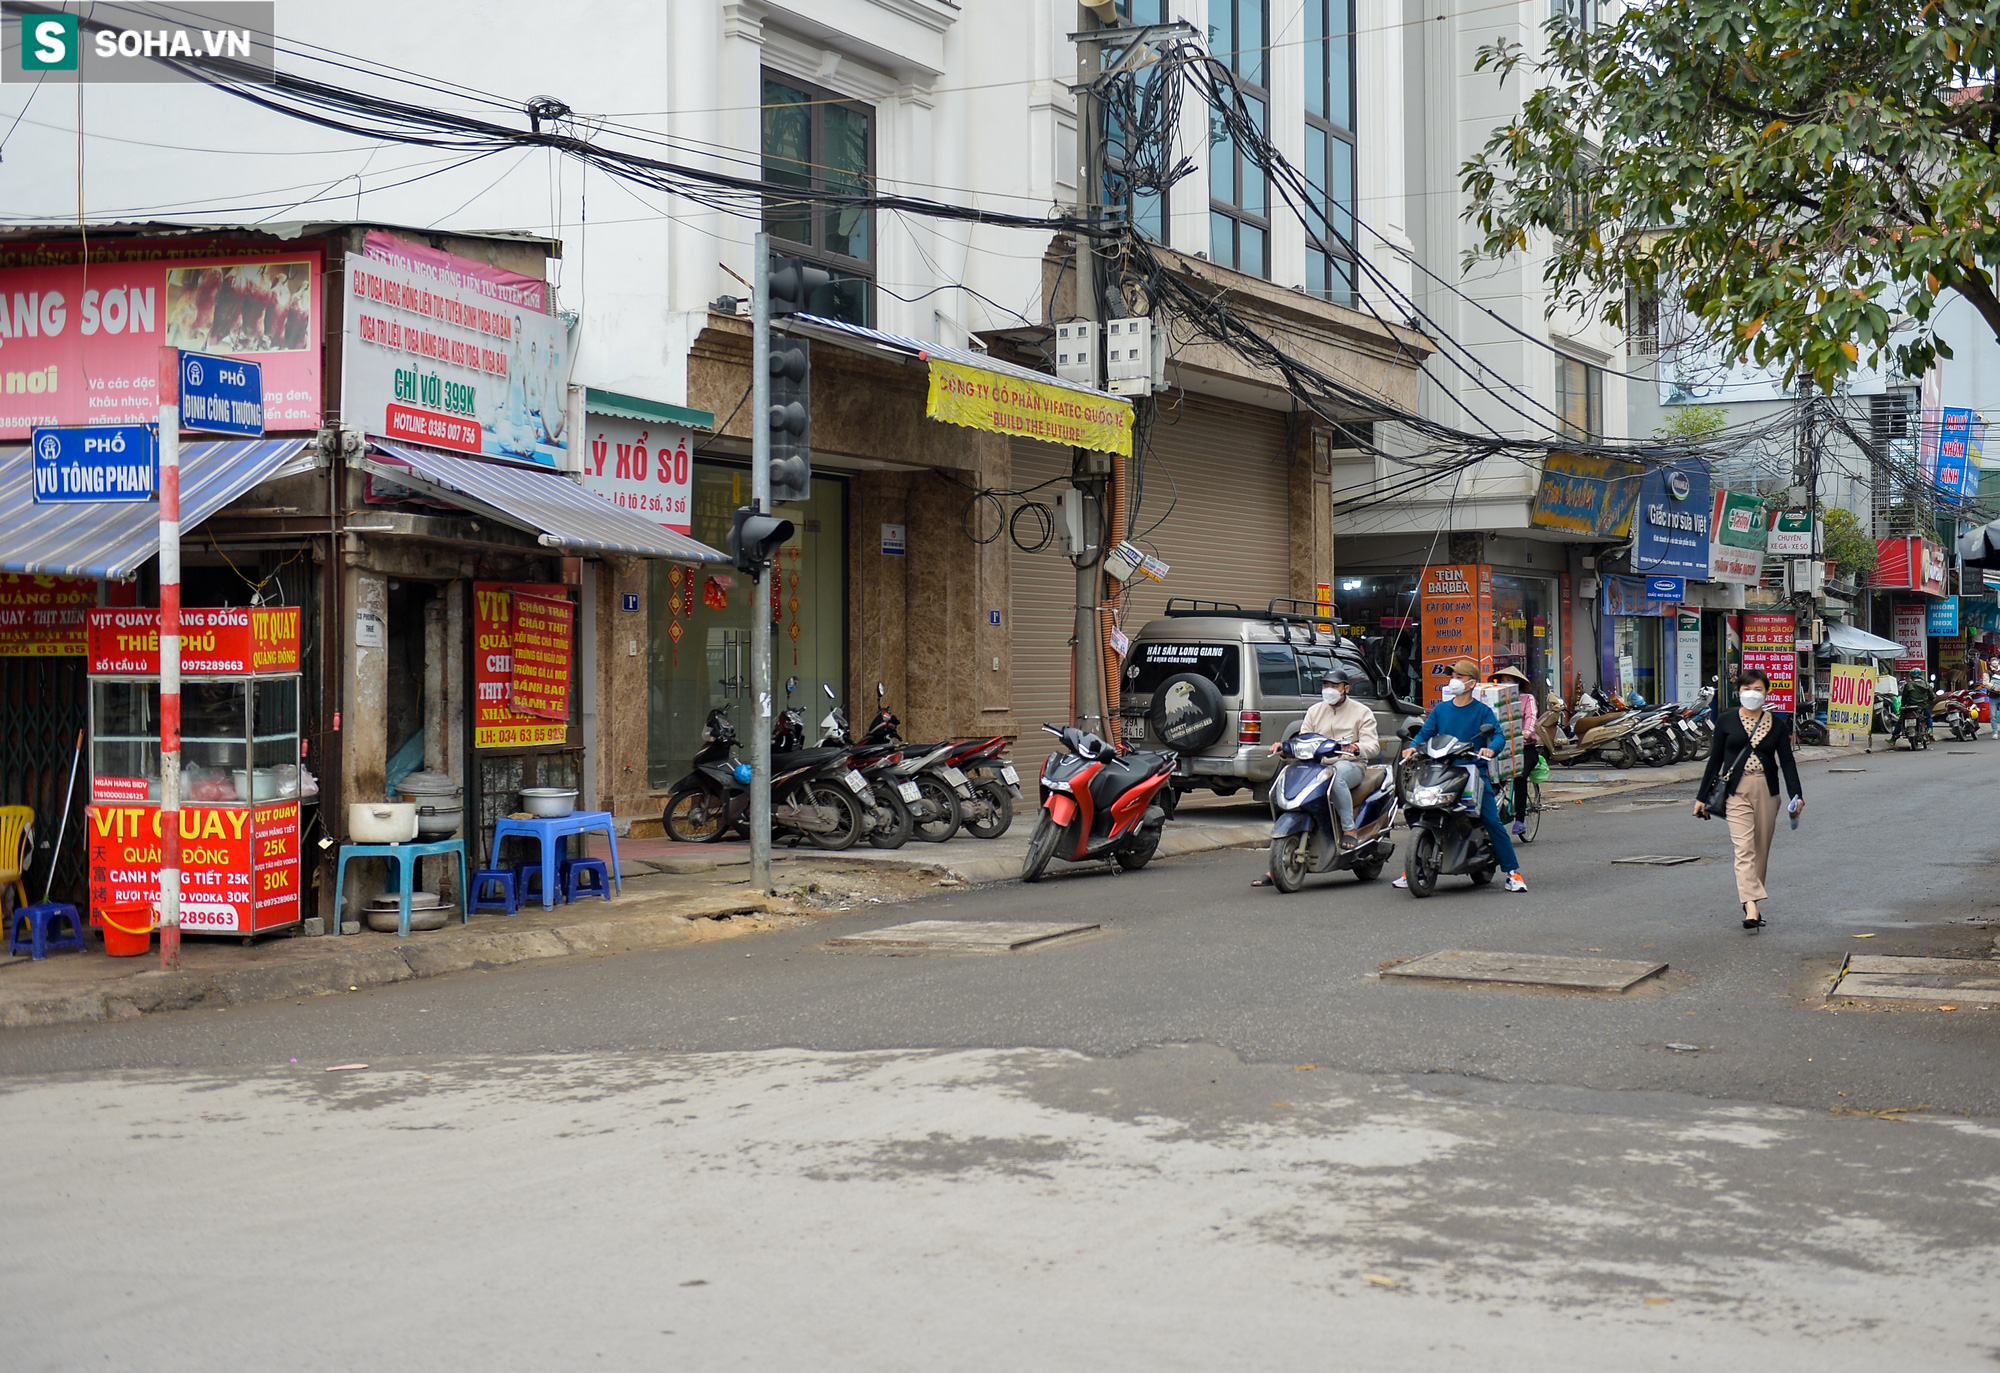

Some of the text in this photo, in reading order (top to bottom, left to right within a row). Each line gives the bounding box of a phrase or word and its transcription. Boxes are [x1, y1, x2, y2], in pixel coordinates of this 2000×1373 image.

[388, 253, 415, 273] YOGA
[81, 284, 155, 335] SƠN
[367, 273, 382, 301] YOGA
[463, 304, 477, 331] SINH
[478, 308, 491, 335] YOGA
[360, 313, 375, 342] YOGA
[404, 326, 419, 354] YOGA
[6, 365, 58, 394] nơi
[89, 377, 155, 391] Và các đặc
[219, 367, 246, 387] PHỐ
[395, 363, 476, 416] CHỈ VỚI 399K
[89, 397, 118, 407] Khâu
[121, 395, 153, 408] nhục,
[940, 374, 974, 397] CÔNG
[977, 383, 989, 399] TY
[992, 382, 1009, 404] CỔ
[1012, 388, 1041, 411] PHẦN
[1043, 398, 1082, 419] VIFATEC
[1084, 405, 1113, 427] QUỐC
[185, 393, 261, 429] ĐỊNH CÔNG THƯỢNG
[394, 412, 476, 444] HOTLINE: 0385 007 756
[1025, 418, 1044, 434] THE
[85, 432, 126, 453] PHỐ
[616, 431, 649, 481] XỔ
[657, 437, 688, 485] SỐ
[37, 461, 150, 493] VŨ TÔNG PHAN
[1941, 464, 1959, 484] KÍNH
[640, 493, 686, 513] 2 số, 3 số
[1648, 504, 1667, 527] Giấc
[1680, 511, 1693, 532] sữa
[1694, 514, 1707, 537] Việt
[1801, 541, 1808, 550] SỐ
[1435, 568, 1463, 581] TÙN
[1428, 581, 1469, 593] BARBER
[91, 610, 248, 629] VỊT QUAY ĐÔNG
[477, 590, 510, 629] VỊT
[519, 601, 568, 618] CHÁO TRAI
[252, 612, 296, 646] VỊT QUAY
[518, 616, 568, 636] CHÁO THỊT
[37, 645, 85, 653] 63 65
[117, 631, 161, 651] THIÊ
[180, 631, 215, 651] PHÚ
[1147, 645, 1224, 657] HẢI SẢN LONG GIANG
[96, 657, 244, 671] SỐ 1 CẦU 0975289663
[254, 647, 295, 668] QUẢNG ĐÔNG
[1783, 662, 1793, 671] SỐ
[1774, 672, 1791, 680] ĐIỆN
[479, 682, 503, 704] THỊT
[514, 680, 543, 693] BÁNH
[544, 684, 565, 695] BAO
[1832, 669, 1872, 706] BÚN ỐC
[1124, 716, 1138, 727] 29A
[1841, 711, 1849, 724] CUA
[481, 726, 564, 744] LH: 034 63 65 929
[95, 779, 147, 789] NGÂN HÀNG BIDV
[255, 805, 297, 825] VỊT QUAY
[92, 808, 249, 843] VỊT UAY
[255, 828, 268, 839] CANH
[284, 823, 296, 834] TIẾT
[182, 846, 229, 865] ĐÔNG
[264, 838, 286, 857] 25K
[110, 869, 249, 885] CANH TIẾT 25K
[264, 870, 289, 890] 30K
[115, 890, 140, 902] RƯỢI
[189, 893, 223, 903] VODKA
[227, 891, 249, 903] 30K
